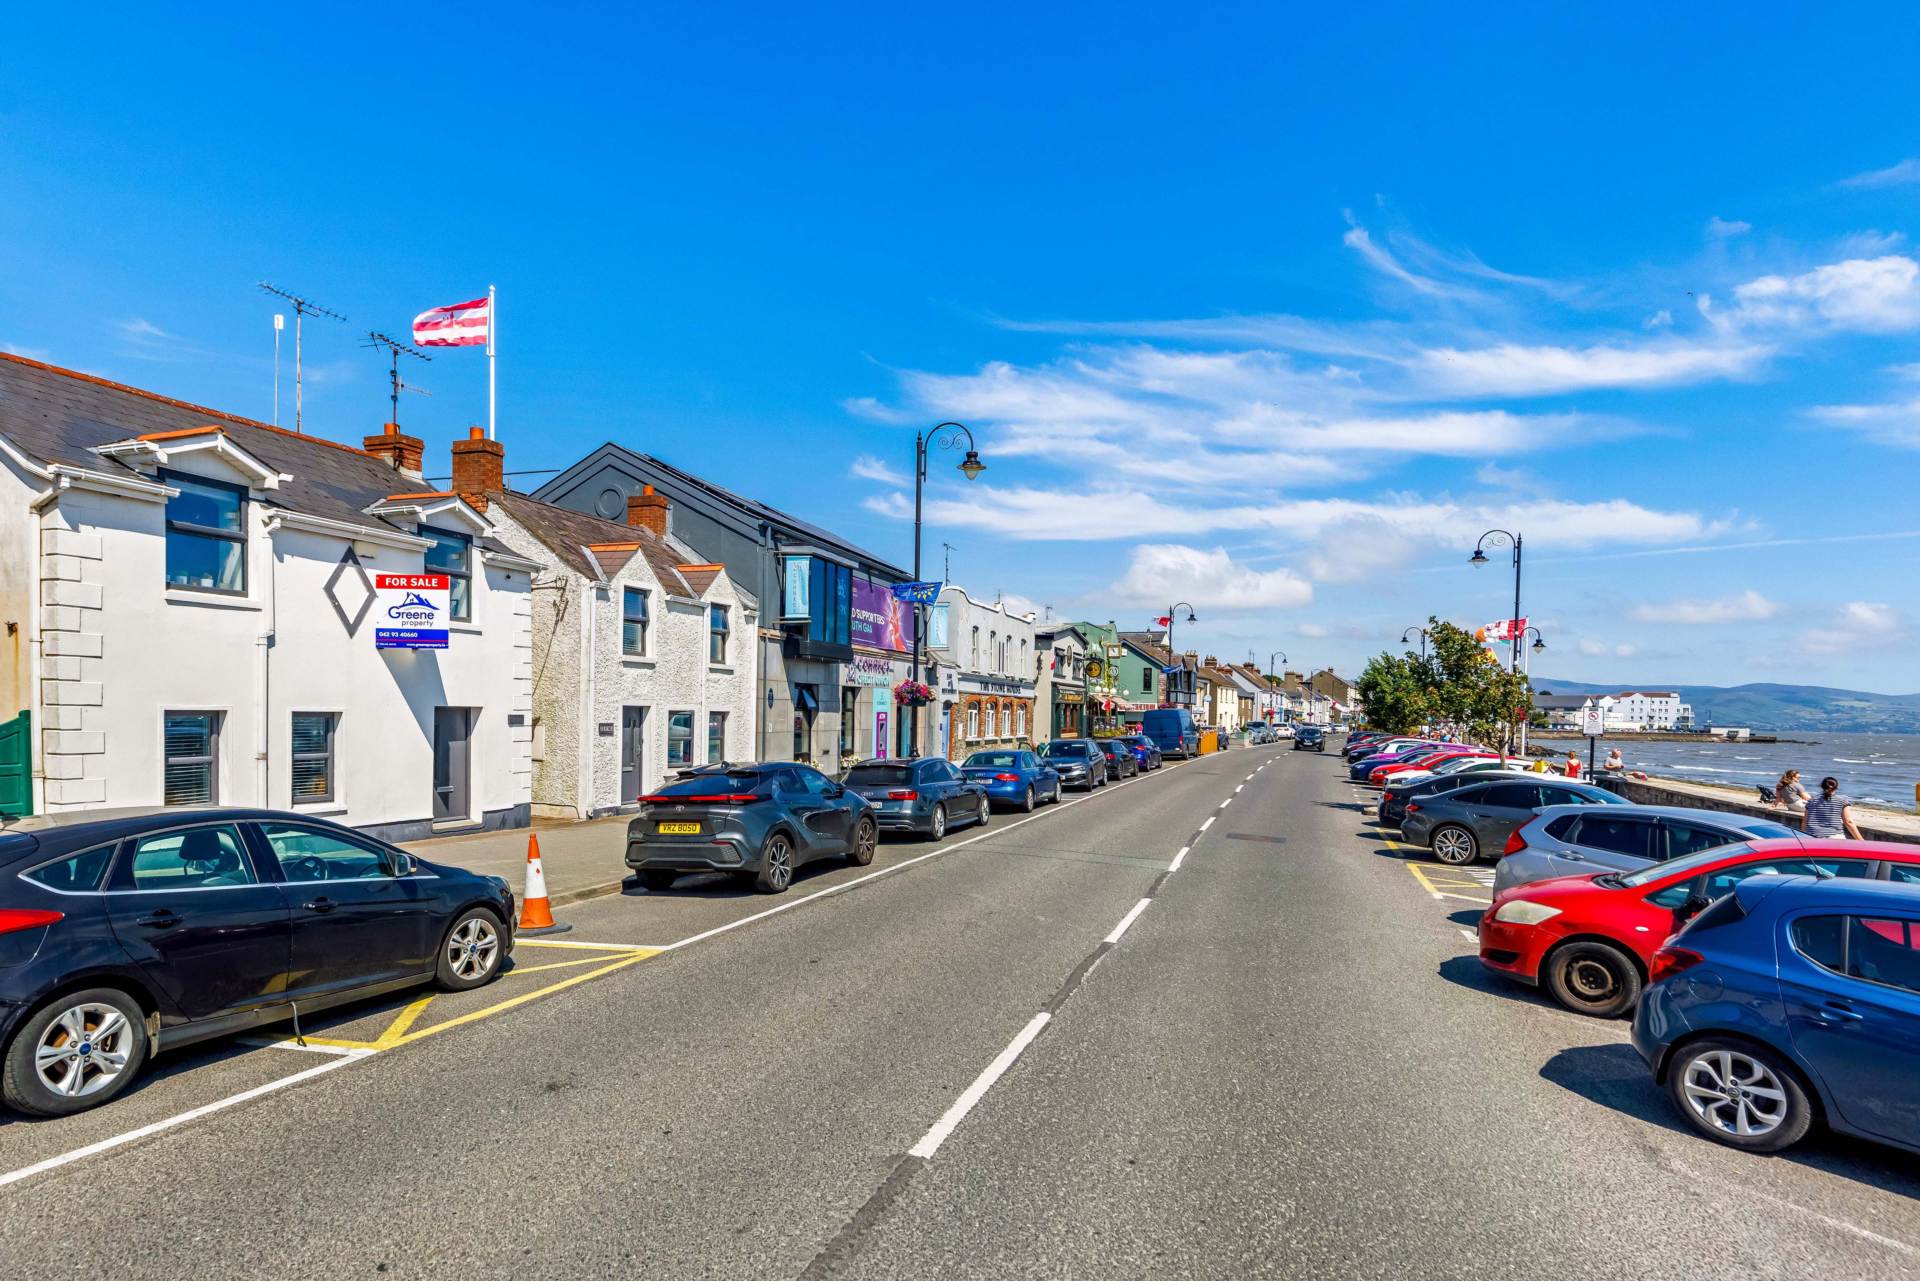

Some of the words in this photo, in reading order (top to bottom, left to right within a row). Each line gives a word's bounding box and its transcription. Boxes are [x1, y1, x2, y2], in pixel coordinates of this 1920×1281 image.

[385, 578, 407, 586] FOR
[410, 578, 438, 586] SALE
[388, 606, 434, 620] Greene
[856, 608, 885, 625] SUPPORTERS
[852, 620, 863, 632] UTH
[863, 622, 873, 633] GAA
[980, 681, 990, 692] THE
[990, 682, 1005, 694] STONE
[1006, 685, 1021, 694] HOUSE
[663, 824, 677, 832] VRZ
